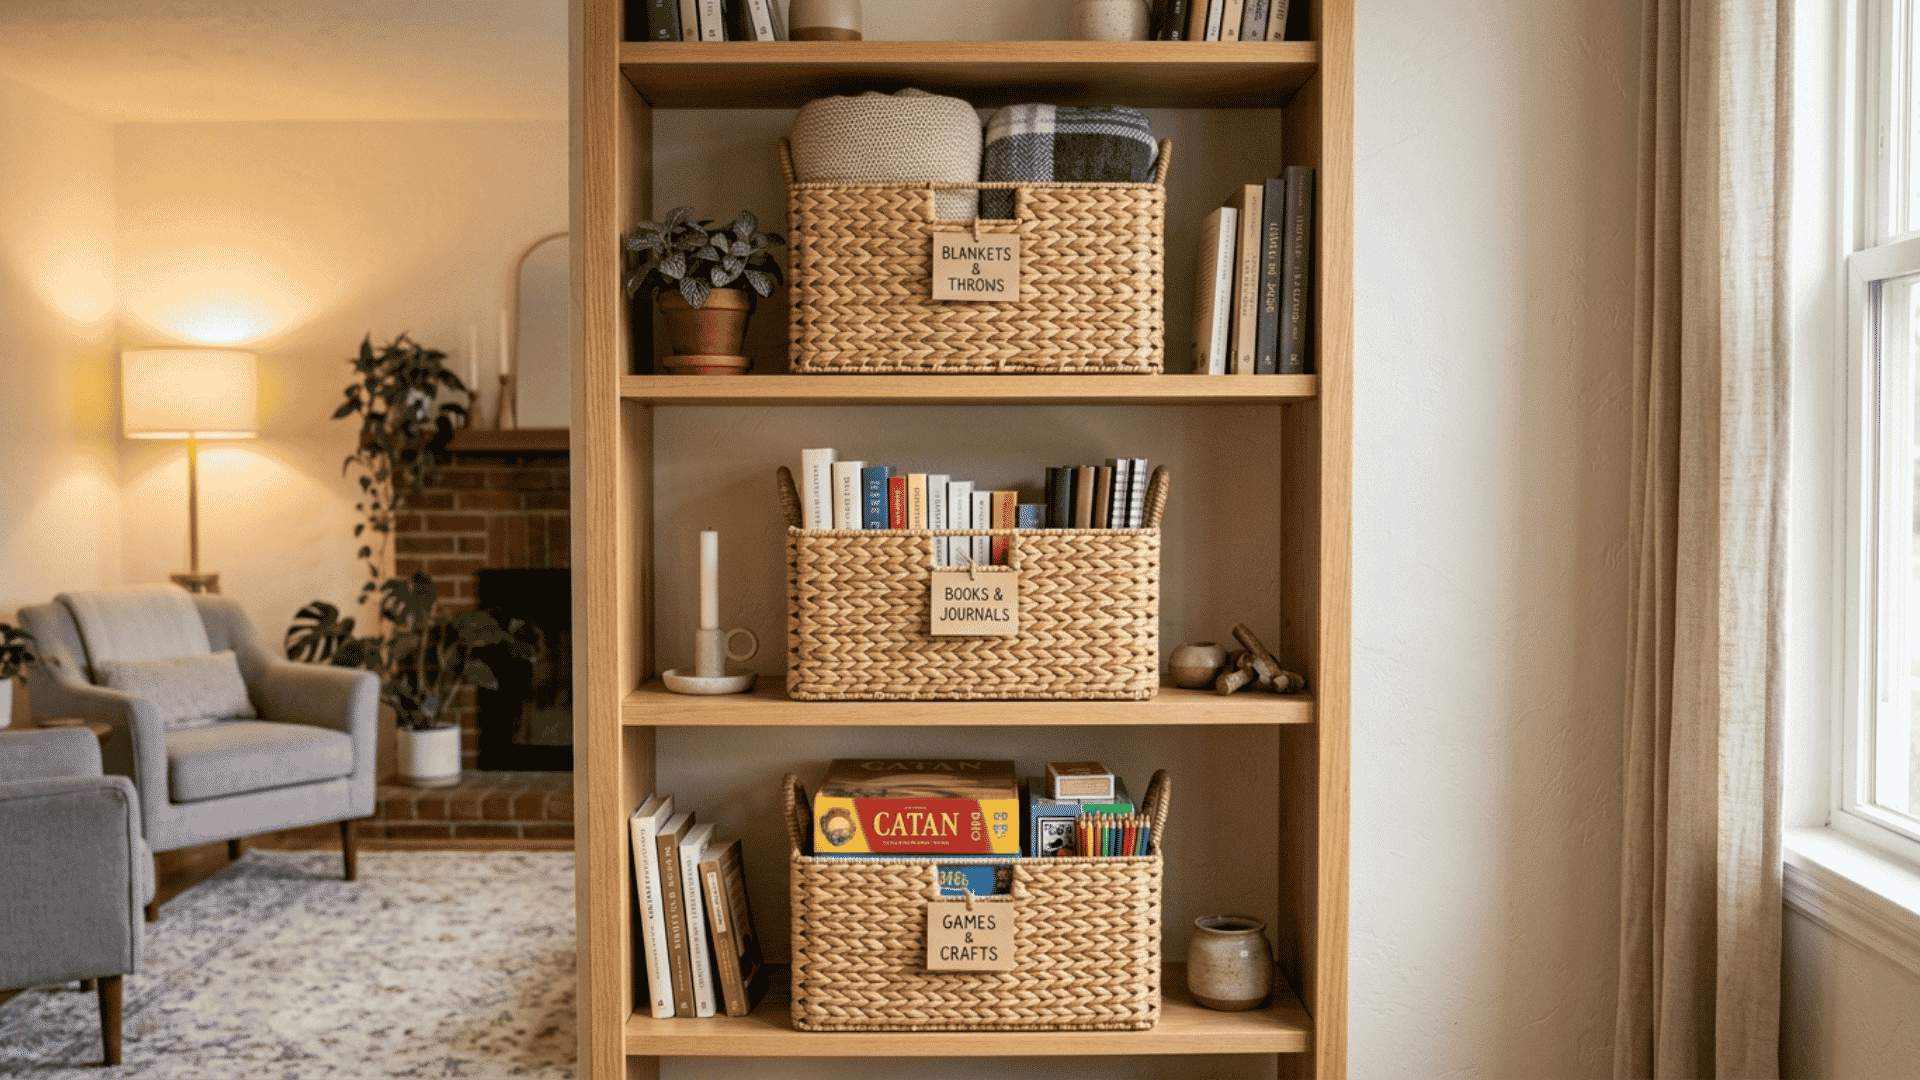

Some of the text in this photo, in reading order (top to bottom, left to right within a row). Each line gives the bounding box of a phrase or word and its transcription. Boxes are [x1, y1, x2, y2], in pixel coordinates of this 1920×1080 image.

[942, 245, 1012, 261] BLANKETS
[971, 262, 981, 275] &
[947, 276, 1005, 292] THRONS
[945, 587, 1003, 601] BOOKS &
[940, 607, 1010, 621] JOURNALS
[873, 811, 960, 837] CATAN
[942, 914, 996, 930] GAMES
[964, 931, 974, 943] &
[940, 946, 998, 961] CRAFTS
